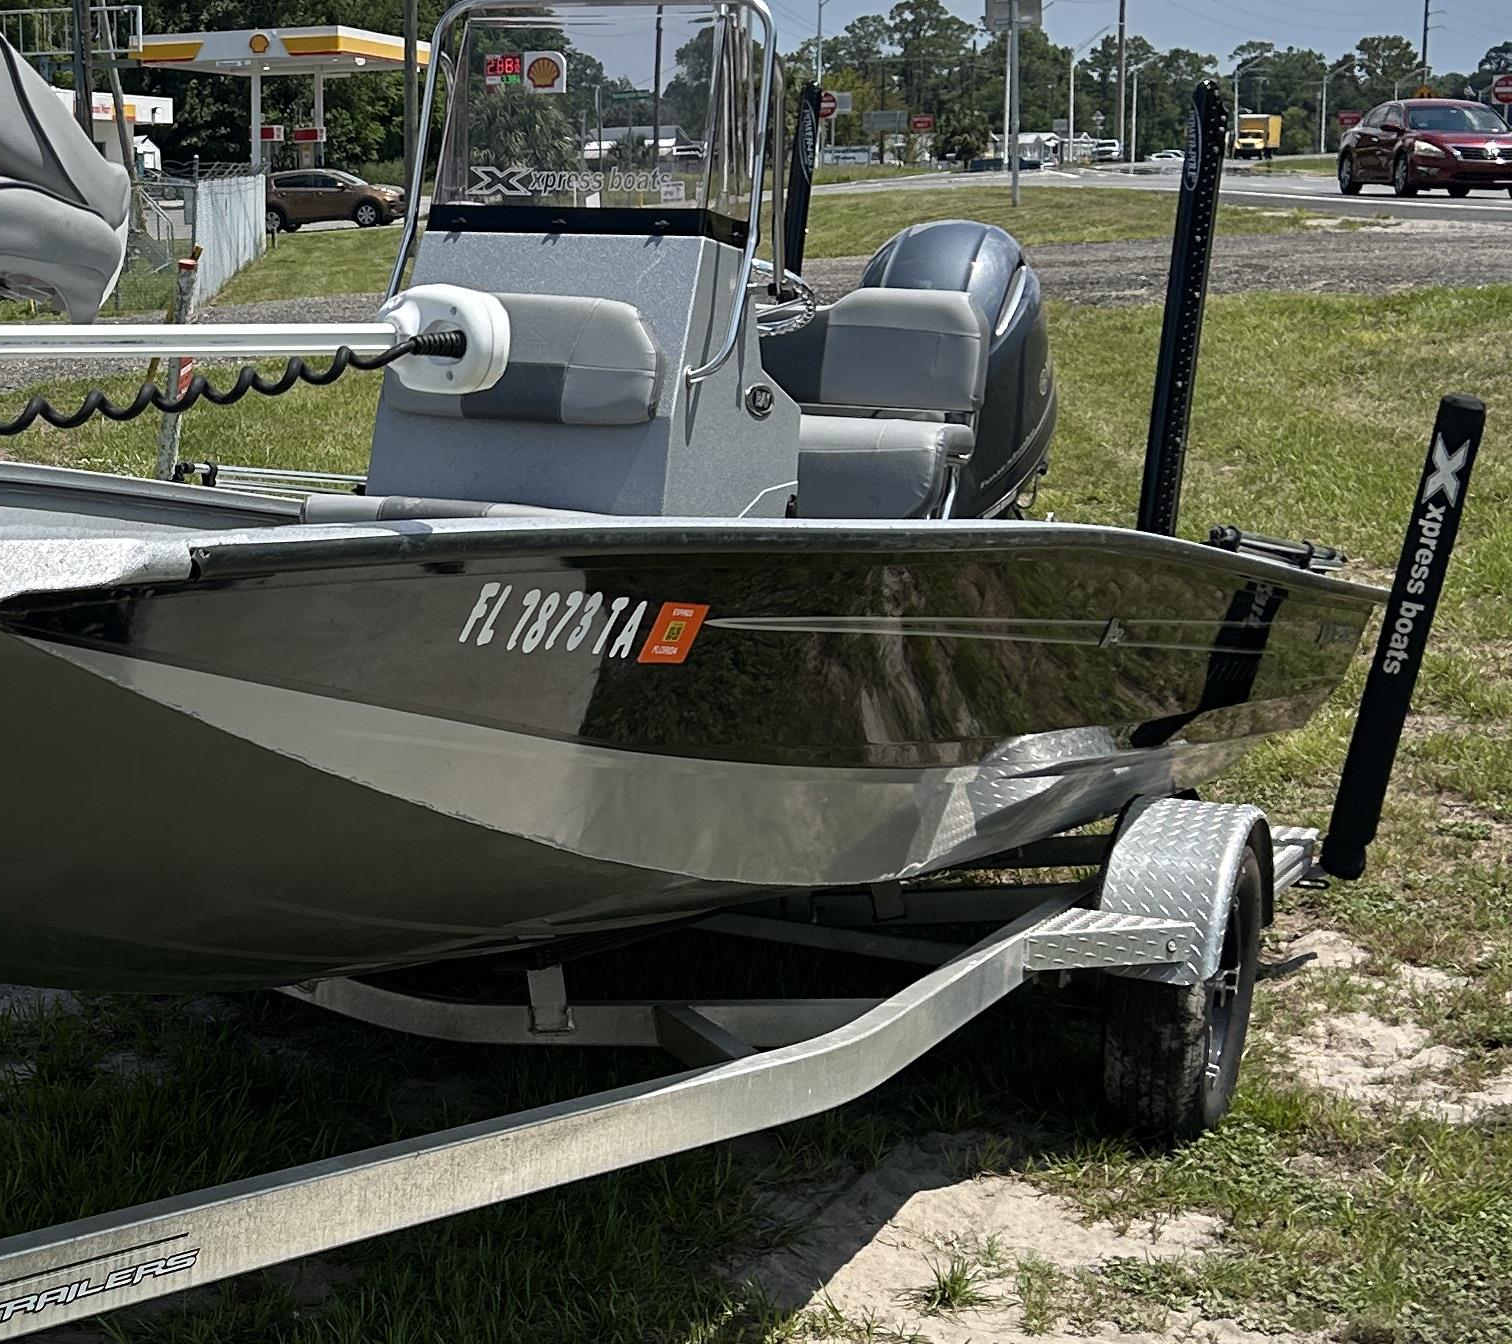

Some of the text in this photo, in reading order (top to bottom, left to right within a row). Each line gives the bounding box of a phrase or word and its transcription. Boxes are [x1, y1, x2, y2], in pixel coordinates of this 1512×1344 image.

[528, 170, 604, 197] xpress
[1406, 502, 1447, 595] xpress
[459, 582, 513, 646] FL
[592, 597, 648, 659] TA
[1382, 600, 1425, 675] boats
